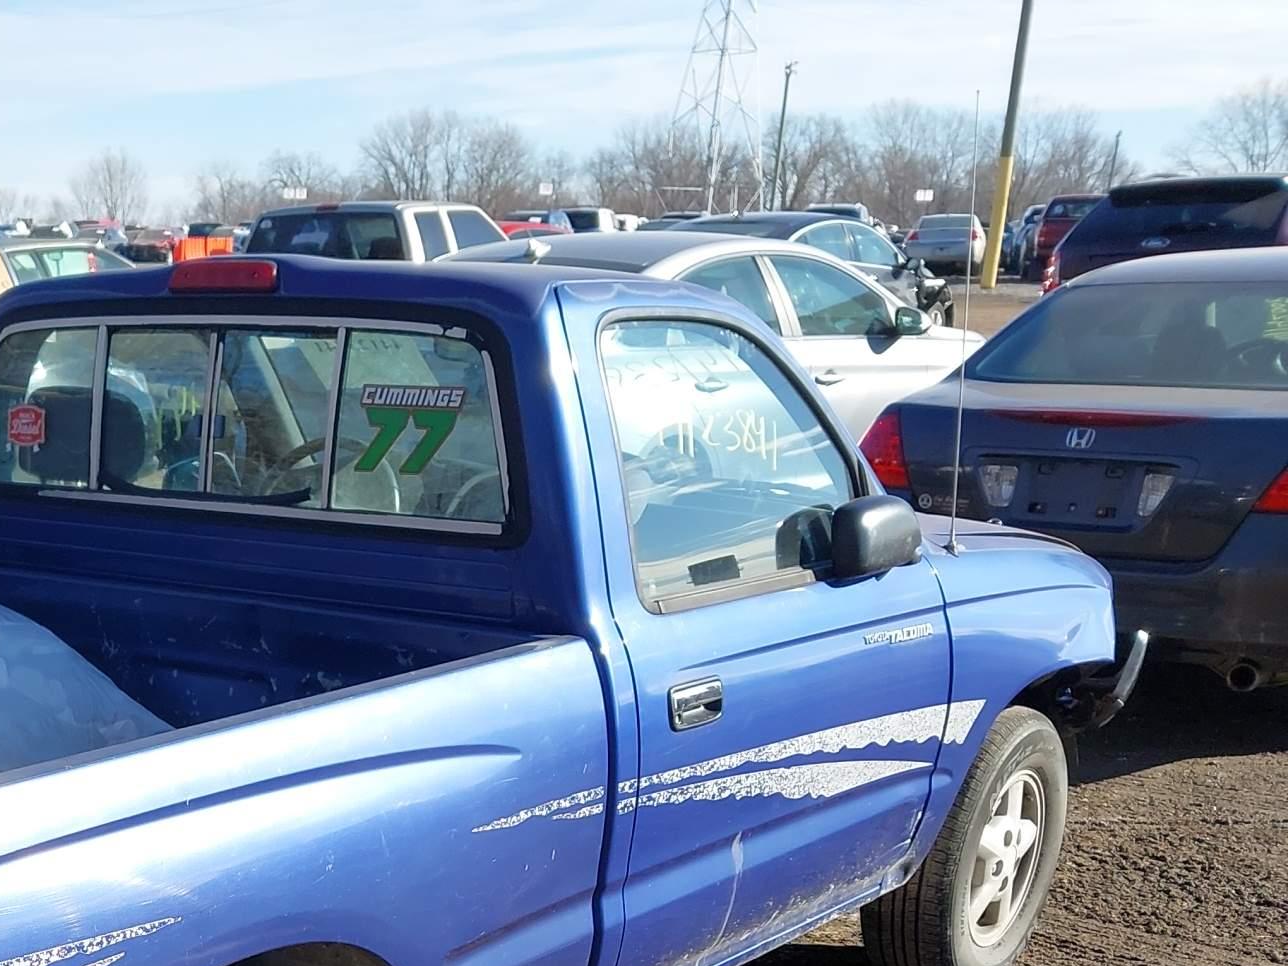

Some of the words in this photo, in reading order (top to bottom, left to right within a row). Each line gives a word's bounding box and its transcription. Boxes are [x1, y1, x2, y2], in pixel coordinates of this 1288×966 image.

[361, 386, 465, 408] CUMMINGS
[353, 407, 459, 476] 77
[890, 622, 933, 645] TACOMA
